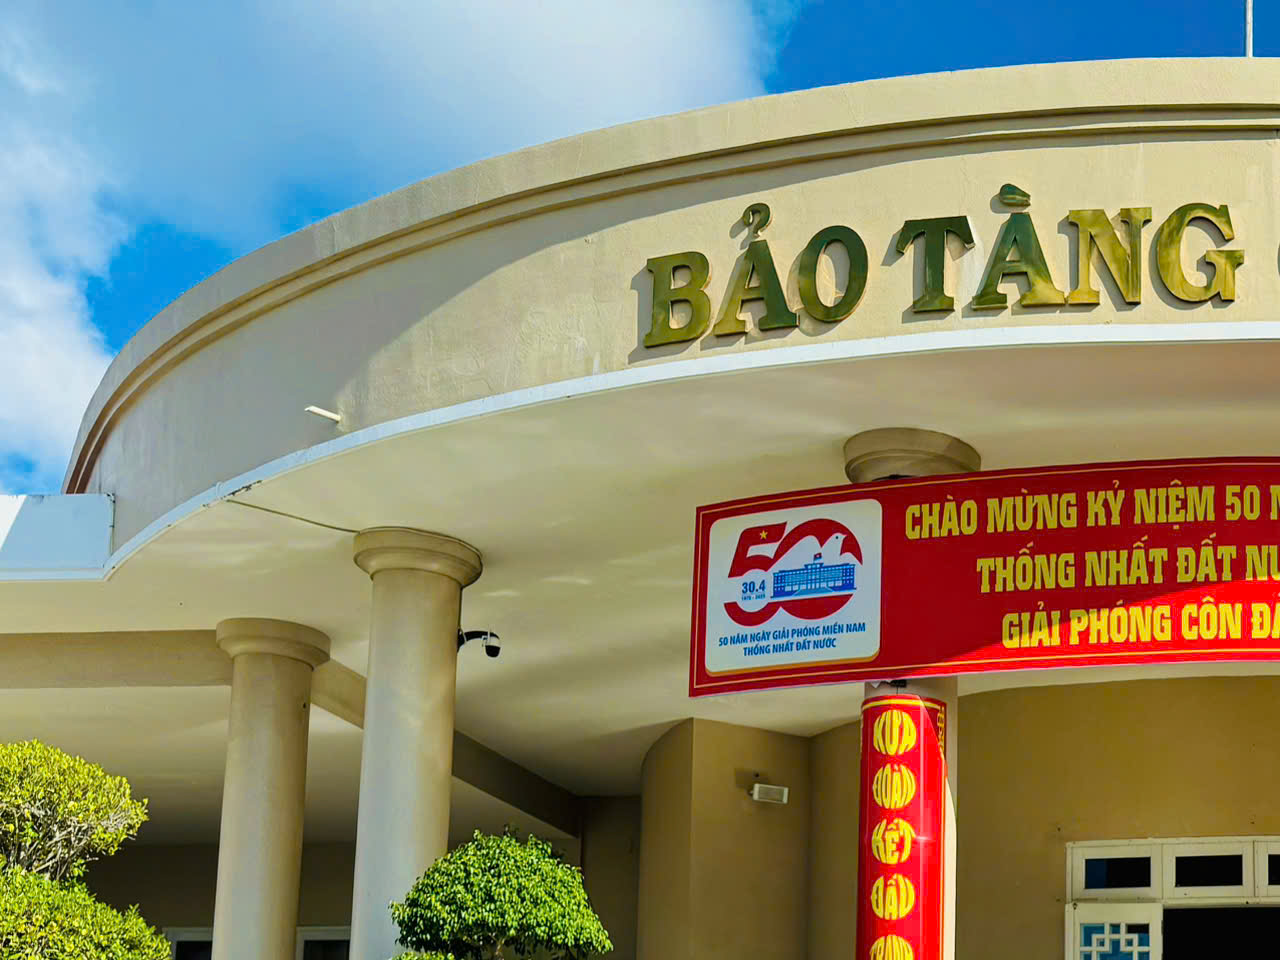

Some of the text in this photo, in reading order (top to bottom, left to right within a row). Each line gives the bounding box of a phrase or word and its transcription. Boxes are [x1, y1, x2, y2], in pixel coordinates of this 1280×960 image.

[644, 203, 868, 348] BẢO
[896, 183, 1245, 312] TÀNG
[905, 494, 978, 540] CHÀO
[986, 488, 1078, 534] MỪNG
[1086, 480, 1125, 527] KỶ
[1133, 479, 1215, 531] NIỆM
[1225, 484, 1261, 521] 50
[741, 579, 766, 594] 30.4
[976, 541, 1076, 594] THỐNG
[1085, 535, 1168, 587] NHẤT
[1177, 532, 1236, 583] ĐẤT
[718, 637, 728, 647] 50
[749, 629, 771, 643] NGÀY
[772, 626, 790, 640] GIẢI
[791, 626, 820, 639] PHÓNG
[846, 622, 866, 633] NAM
[1002, 601, 1061, 649] GIẢI
[1068, 599, 1172, 645] PHÓNG
[1181, 596, 1242, 640] CÔN
[743, 642, 771, 657] THỐNG
[873, 763, 916, 809] ĐOÀN
[871, 817, 915, 865] KẾT
